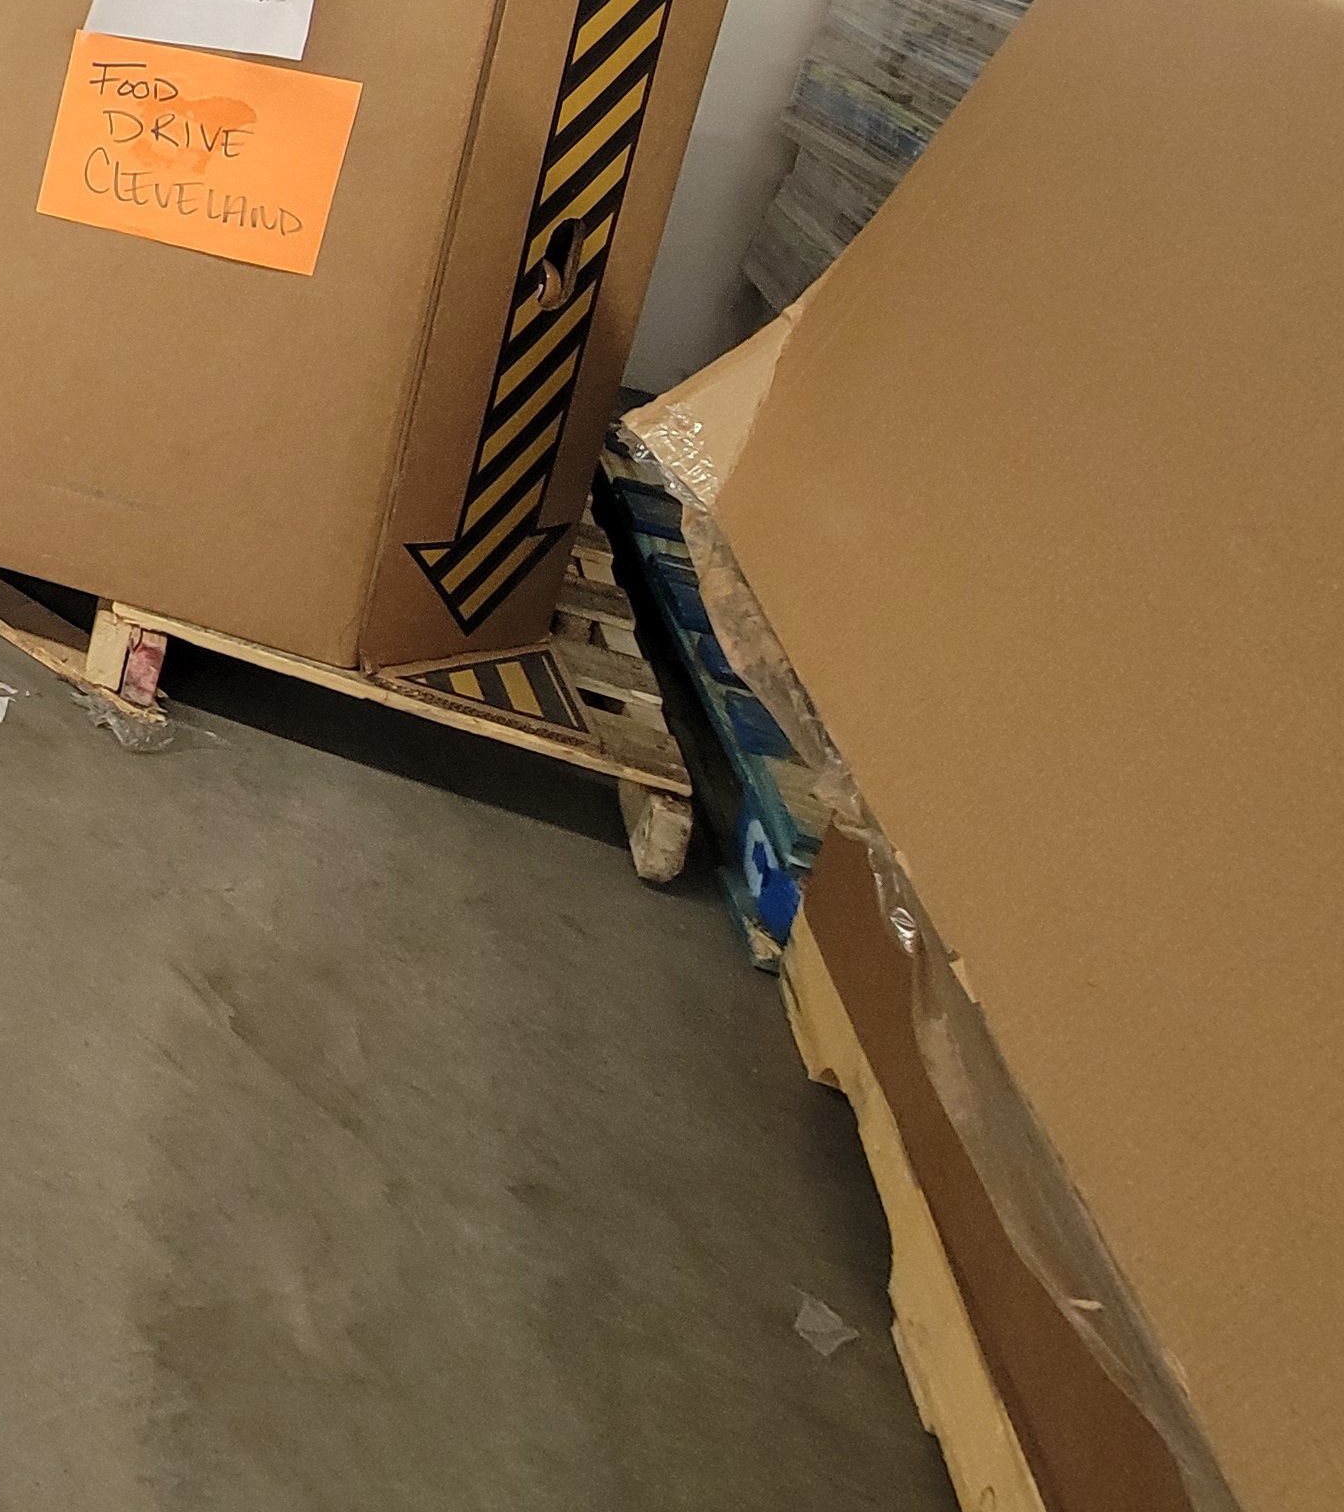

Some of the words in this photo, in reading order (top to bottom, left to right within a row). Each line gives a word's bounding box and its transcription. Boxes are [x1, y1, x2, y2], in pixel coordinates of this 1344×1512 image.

[88, 62, 180, 101] FOOD
[101, 108, 255, 159] DRIVE
[83, 146, 304, 237] CLEVELAND
